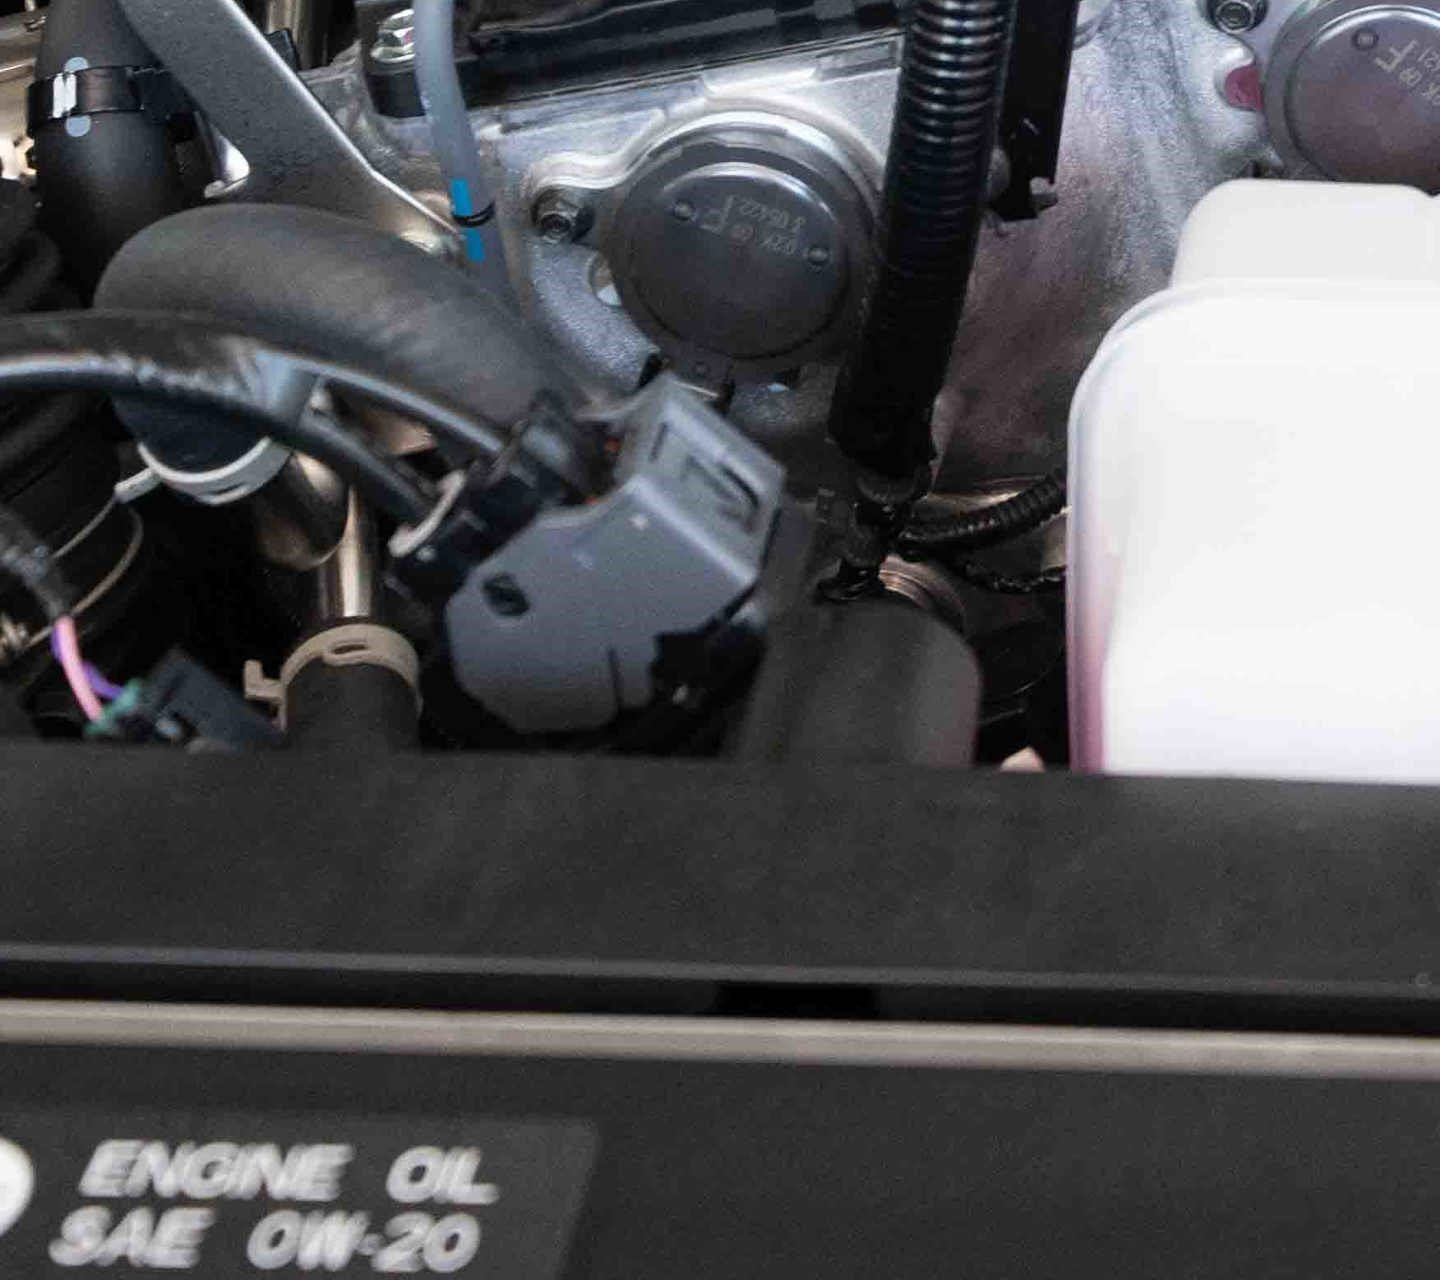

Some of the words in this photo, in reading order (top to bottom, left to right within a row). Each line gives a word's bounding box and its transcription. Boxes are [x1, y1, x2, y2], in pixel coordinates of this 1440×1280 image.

[1373, 38, 1418, 74] F
[696, 194, 735, 236] F
[79, 1139, 353, 1202] ENGINE
[384, 1145, 500, 1205] OIL
[48, 1204, 216, 1269] SAE
[246, 1208, 480, 1273] 0W-20
